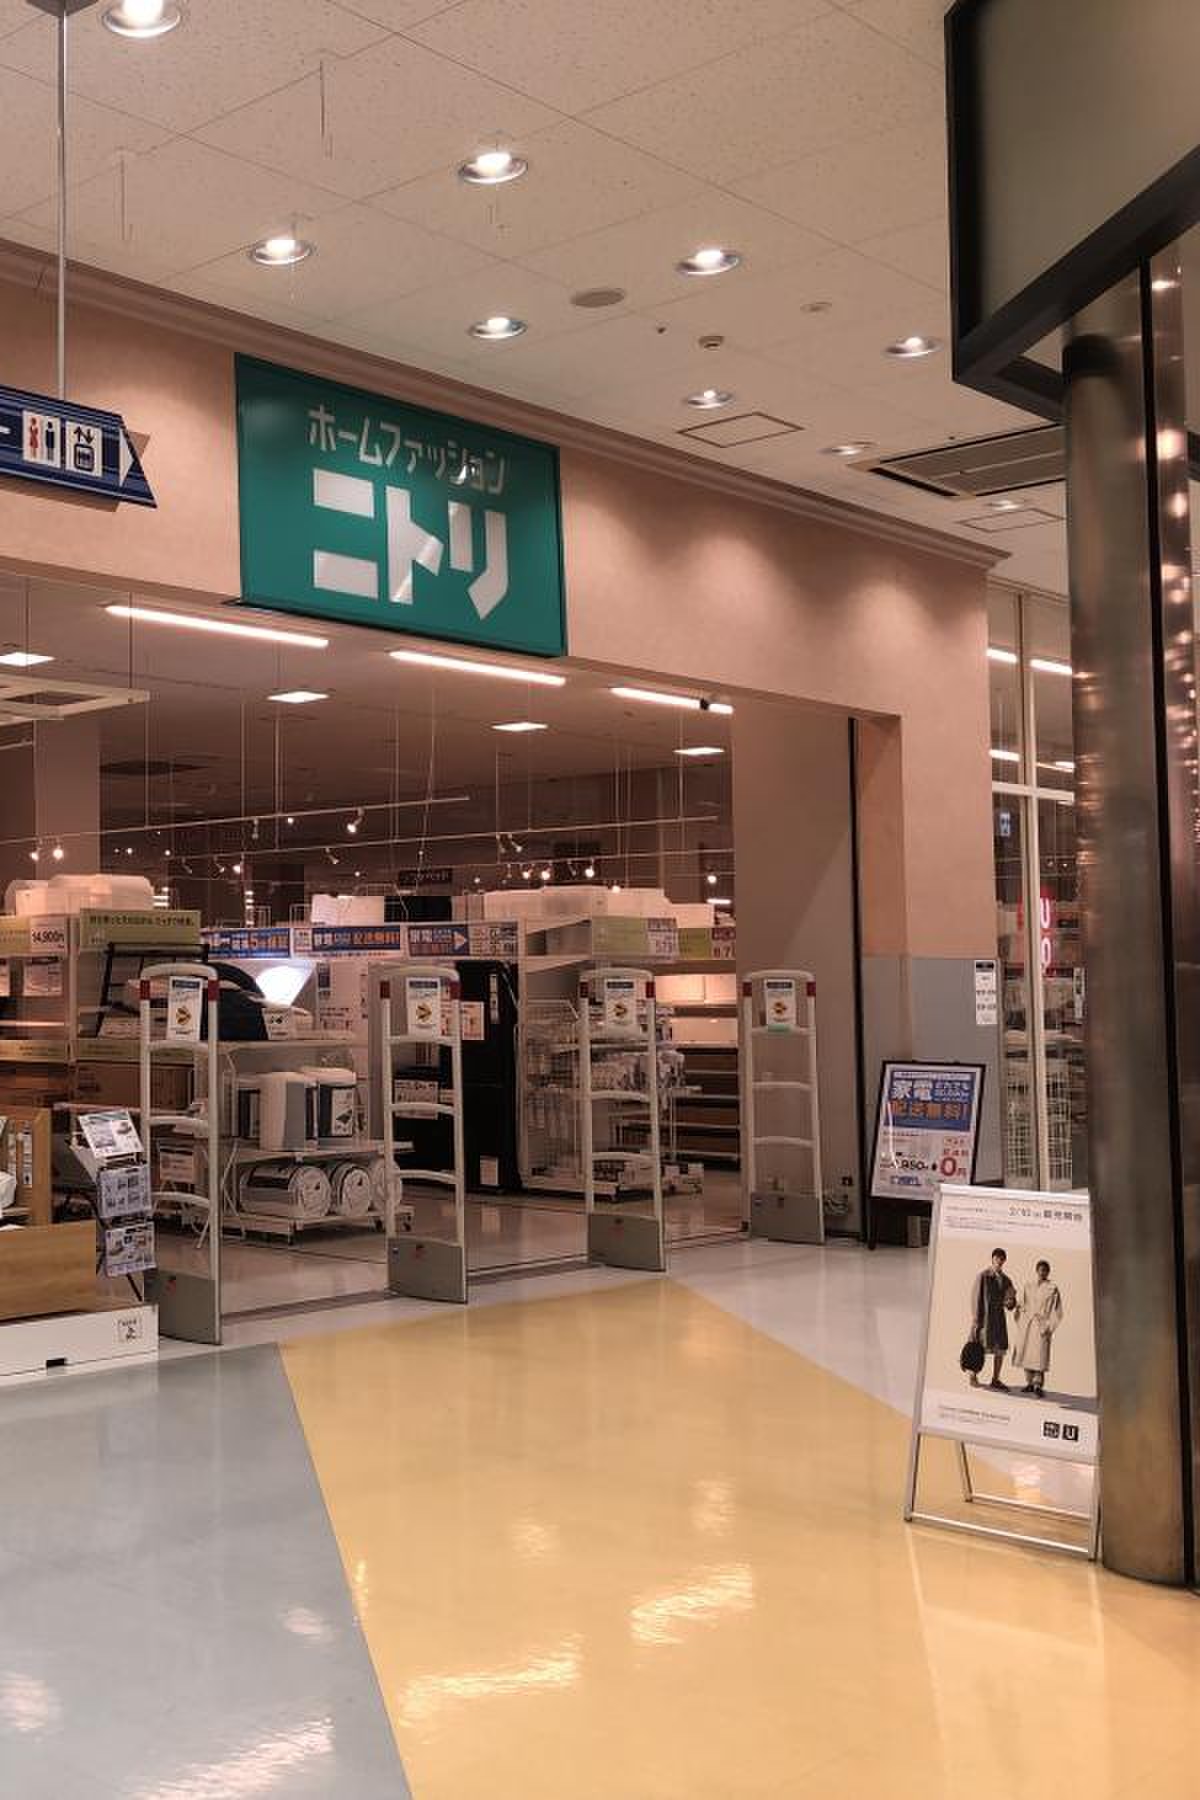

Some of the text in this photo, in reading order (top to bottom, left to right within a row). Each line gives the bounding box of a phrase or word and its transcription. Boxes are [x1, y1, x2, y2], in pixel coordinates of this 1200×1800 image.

[308, 405, 508, 497] ホームファッション
[312, 467, 507, 621] ニトリ
